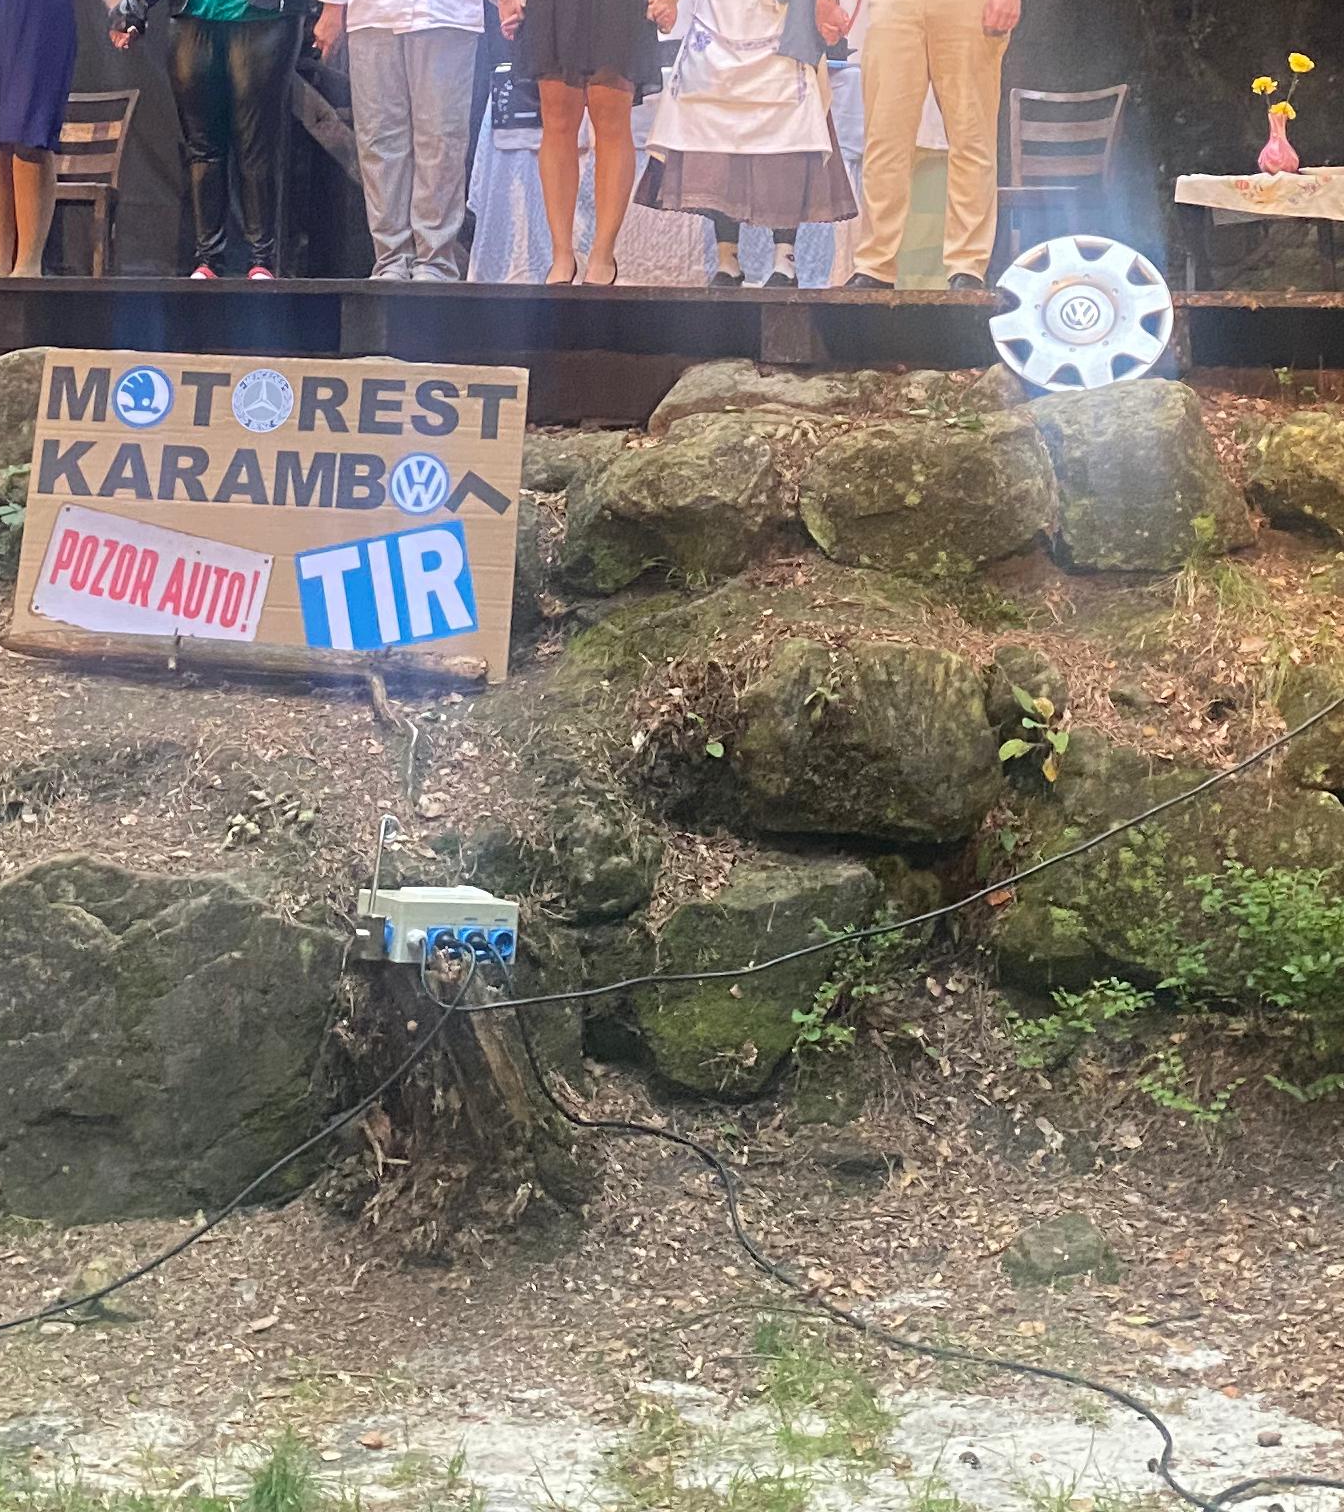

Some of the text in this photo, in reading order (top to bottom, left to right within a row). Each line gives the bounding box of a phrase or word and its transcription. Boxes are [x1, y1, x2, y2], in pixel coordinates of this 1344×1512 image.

[49, 529, 261, 633] POZOR AUTO!
[300, 529, 474, 651] TIR
